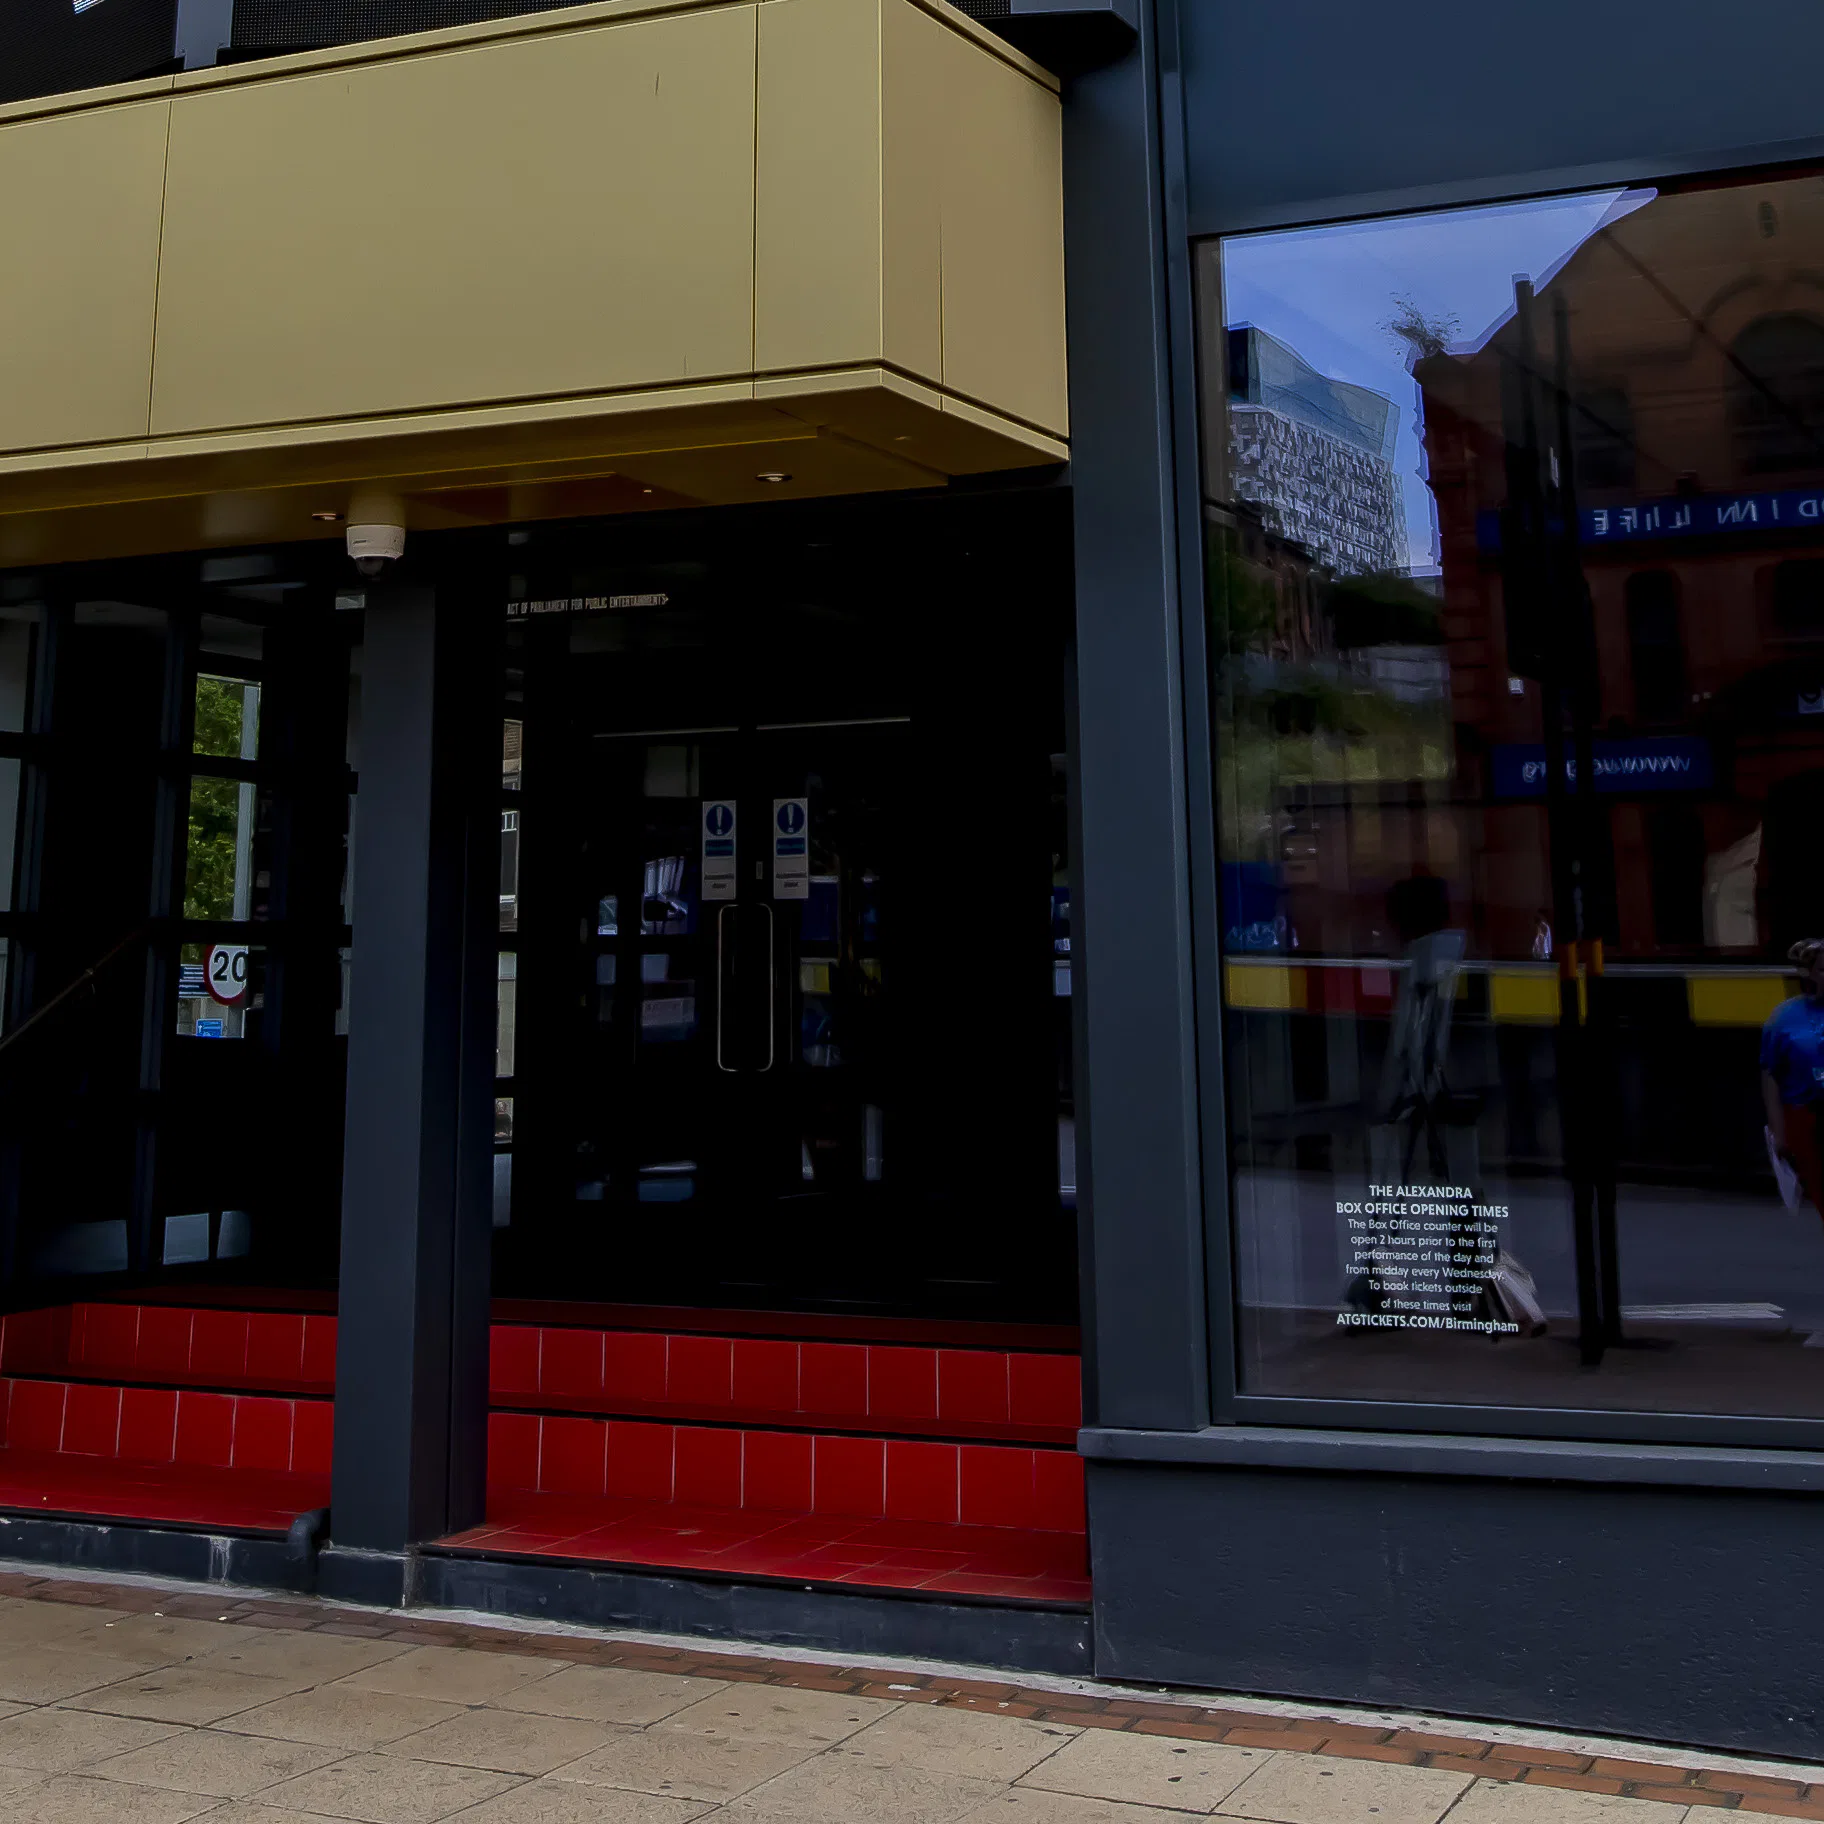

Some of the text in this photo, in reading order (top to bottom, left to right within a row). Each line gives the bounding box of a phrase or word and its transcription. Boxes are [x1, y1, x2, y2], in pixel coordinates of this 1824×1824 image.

[213, 950, 249, 983] 20
[1369, 1185, 1473, 1199] THE ALEXANDRA
[1336, 1202, 1509, 1218] BOX OFFICE OPENING TIMES
[1348, 1219, 1498, 1233] The Box Office counter will be
[1351, 1235, 1496, 1248] open 2 hours prior to the first
[1354, 1250, 1494, 1265] performance of the day and
[1346, 1264, 1369, 1274] from
[1372, 1265, 1409, 1278] midday
[1411, 1268, 1439, 1279] every
[1368, 1280, 1483, 1294] To book tickets outside
[1380, 1298, 1472, 1311] of these times visit
[1336, 1313, 1519, 1333] ATGTICKETS.COM/Birmingham
